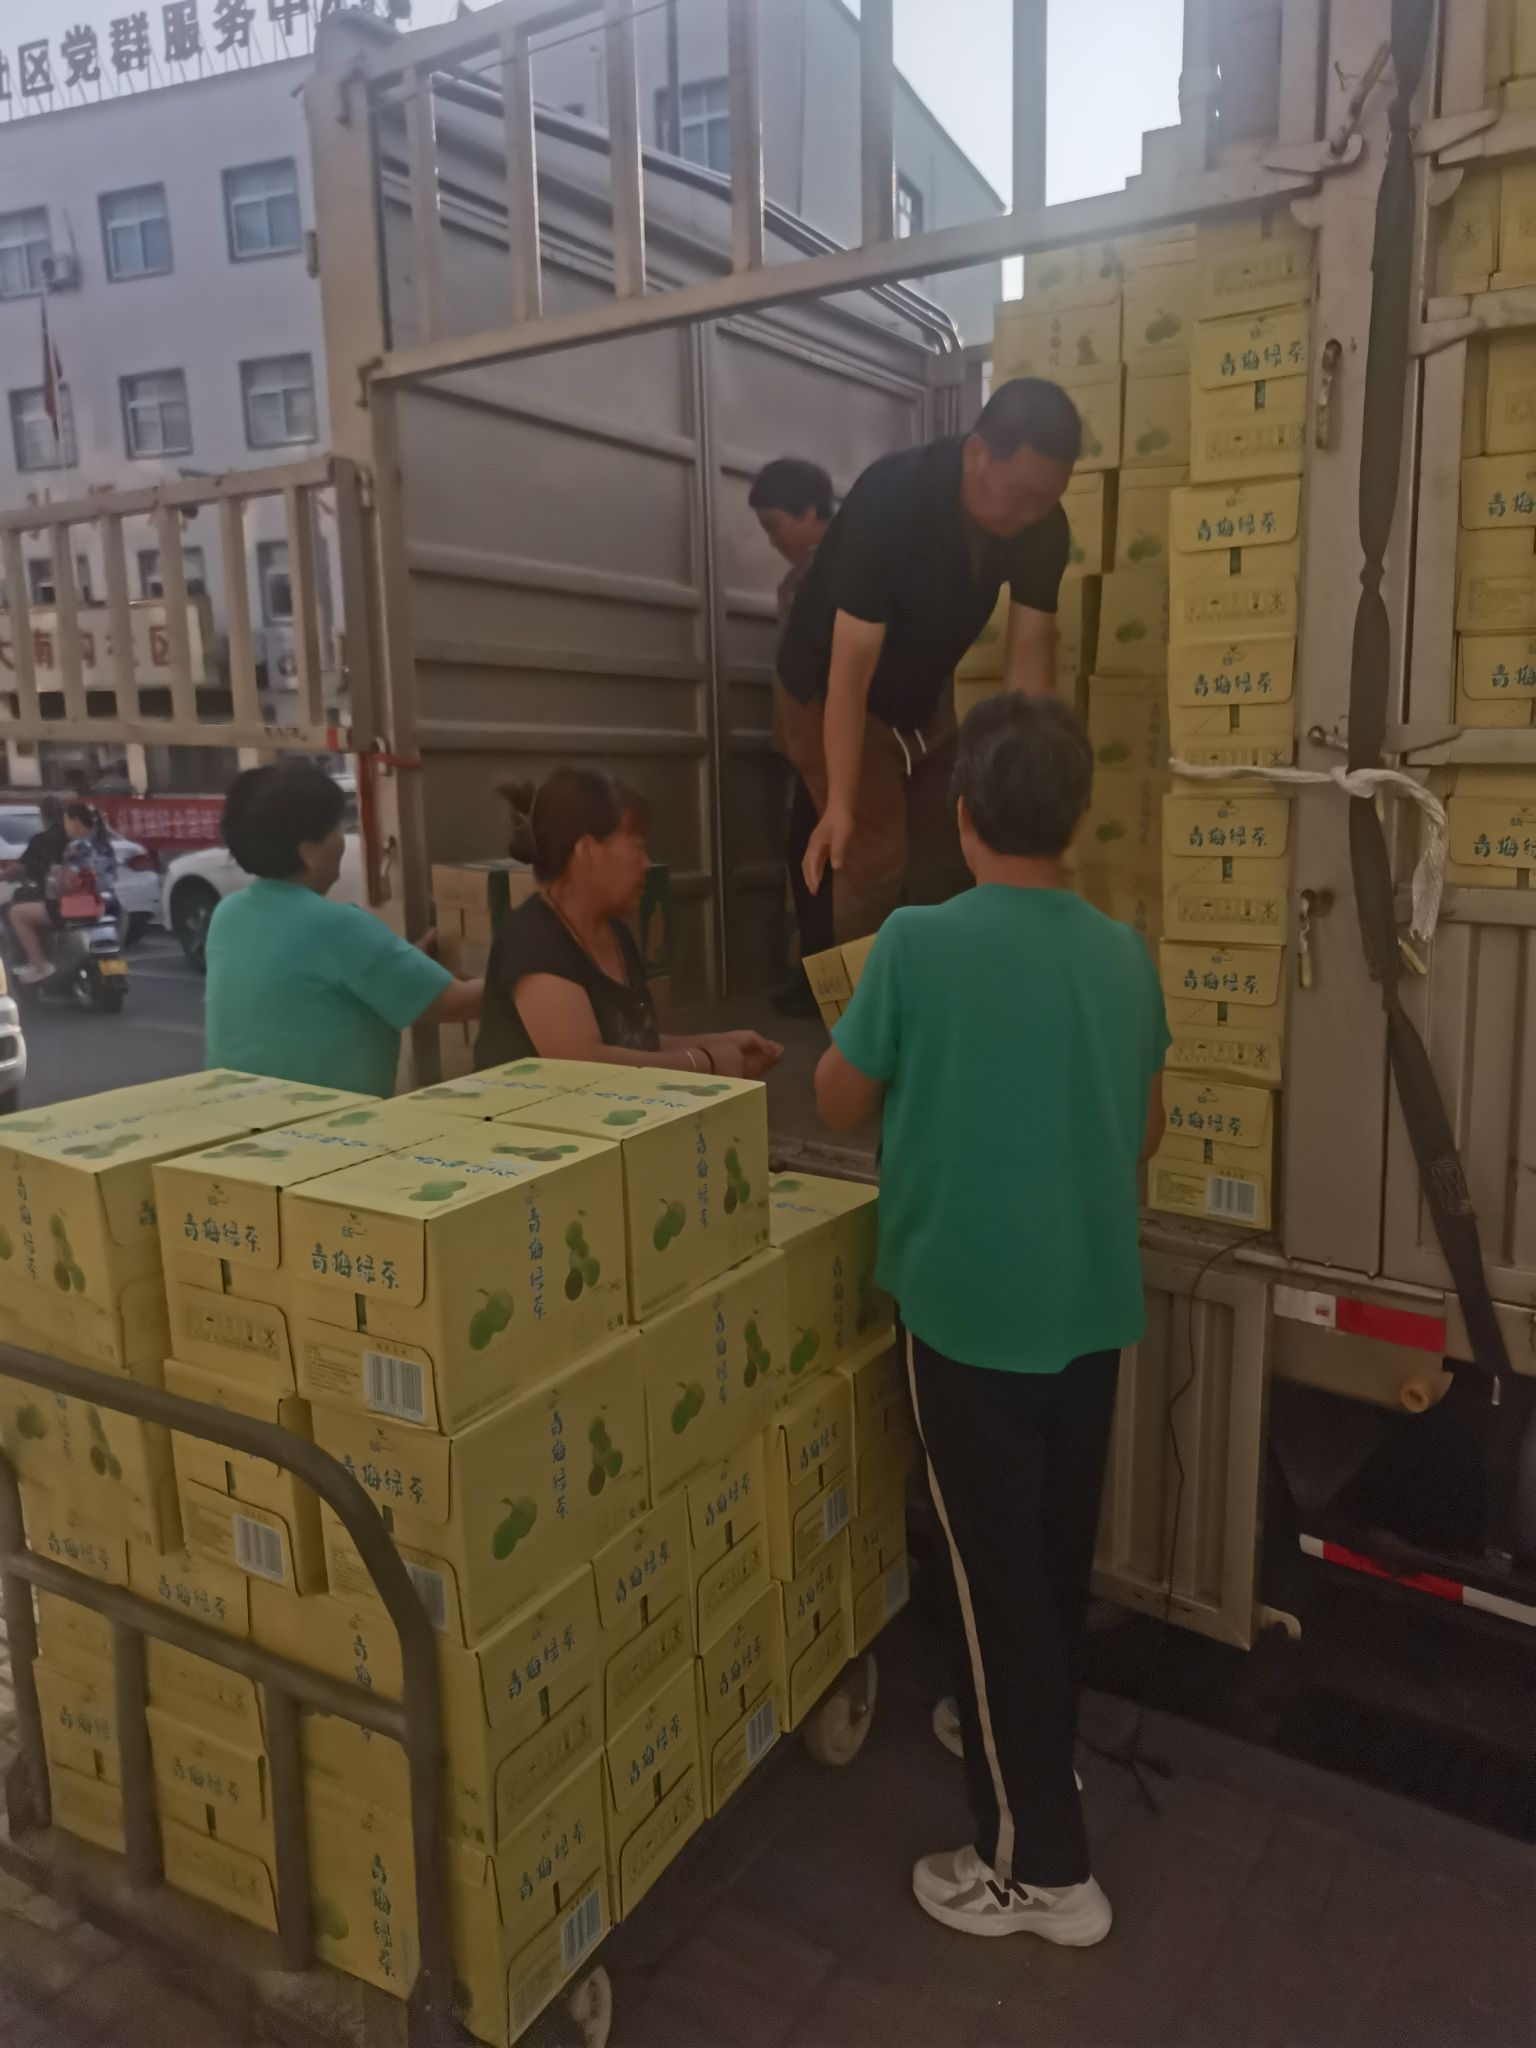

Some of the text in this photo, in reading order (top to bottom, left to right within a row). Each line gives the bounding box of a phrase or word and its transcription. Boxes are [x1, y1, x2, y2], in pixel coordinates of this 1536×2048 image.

[0, 0, 411, 99] 区党群服务中
[1220, 340, 1305, 377] 青梅绿茶
[1197, 511, 1277, 542] 青梅绿茶
[1194, 672, 1272, 697] 青梅绿茶
[1189, 825, 1267, 848] 青梅绿茶
[1184, 969, 1259, 994] 青梅绿茶
[1169, 1106, 1243, 1137] 青梅绿茶
[184, 1213, 261, 1253] 青梅绿茶
[312, 1243, 399, 1290] 青梅绿茶
[528, 1207, 546, 1320] 青梅绿茶
[159, 1575, 229, 1621] 青梅绿茶
[371, 1853, 396, 1978] 青梅绿茶
